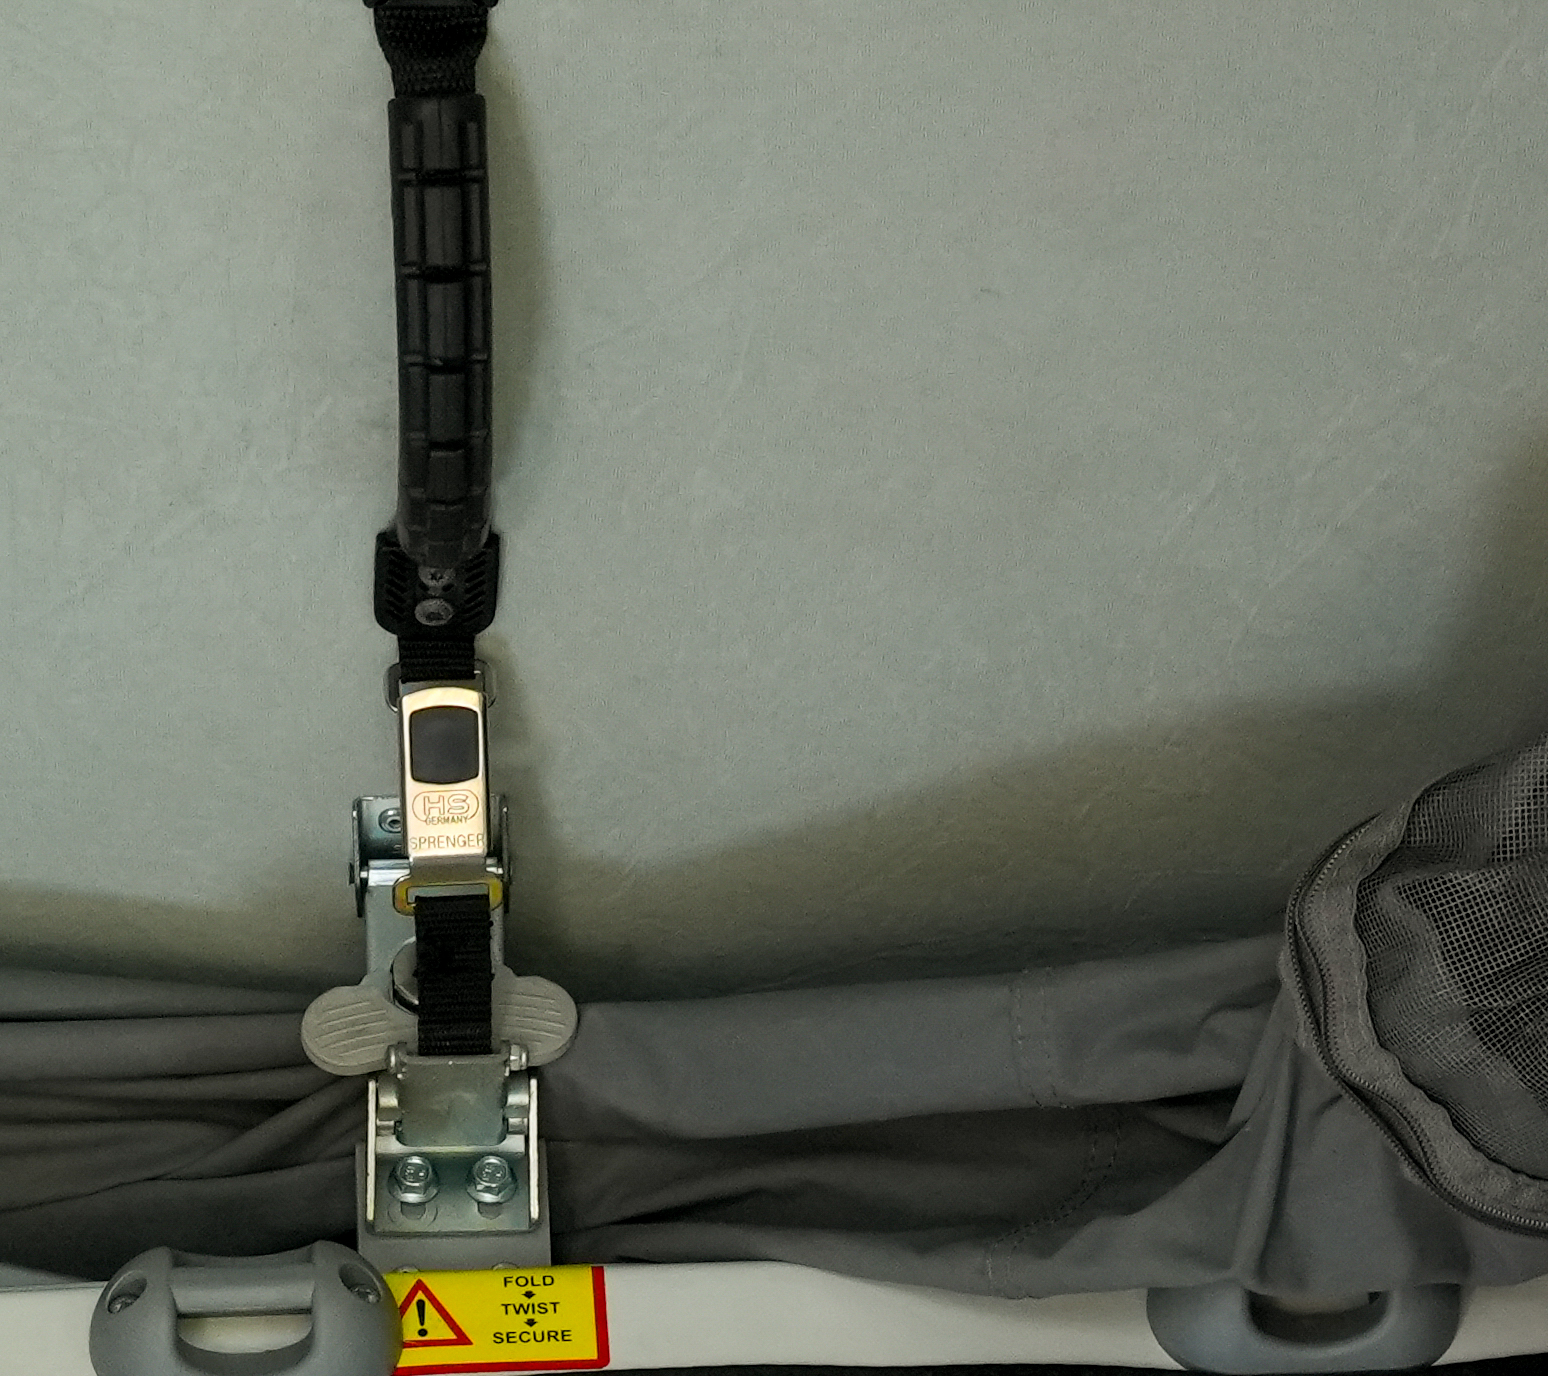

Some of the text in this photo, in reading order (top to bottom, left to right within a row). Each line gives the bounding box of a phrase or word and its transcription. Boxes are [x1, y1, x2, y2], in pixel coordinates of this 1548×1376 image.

[423, 793, 470, 816] HS
[425, 814, 470, 826] GERMANY
[410, 832, 484, 850] SPRENGER
[503, 1275, 555, 1288] FOLD
[501, 1301, 560, 1316] TWIST
[492, 1329, 573, 1345] SECURE
